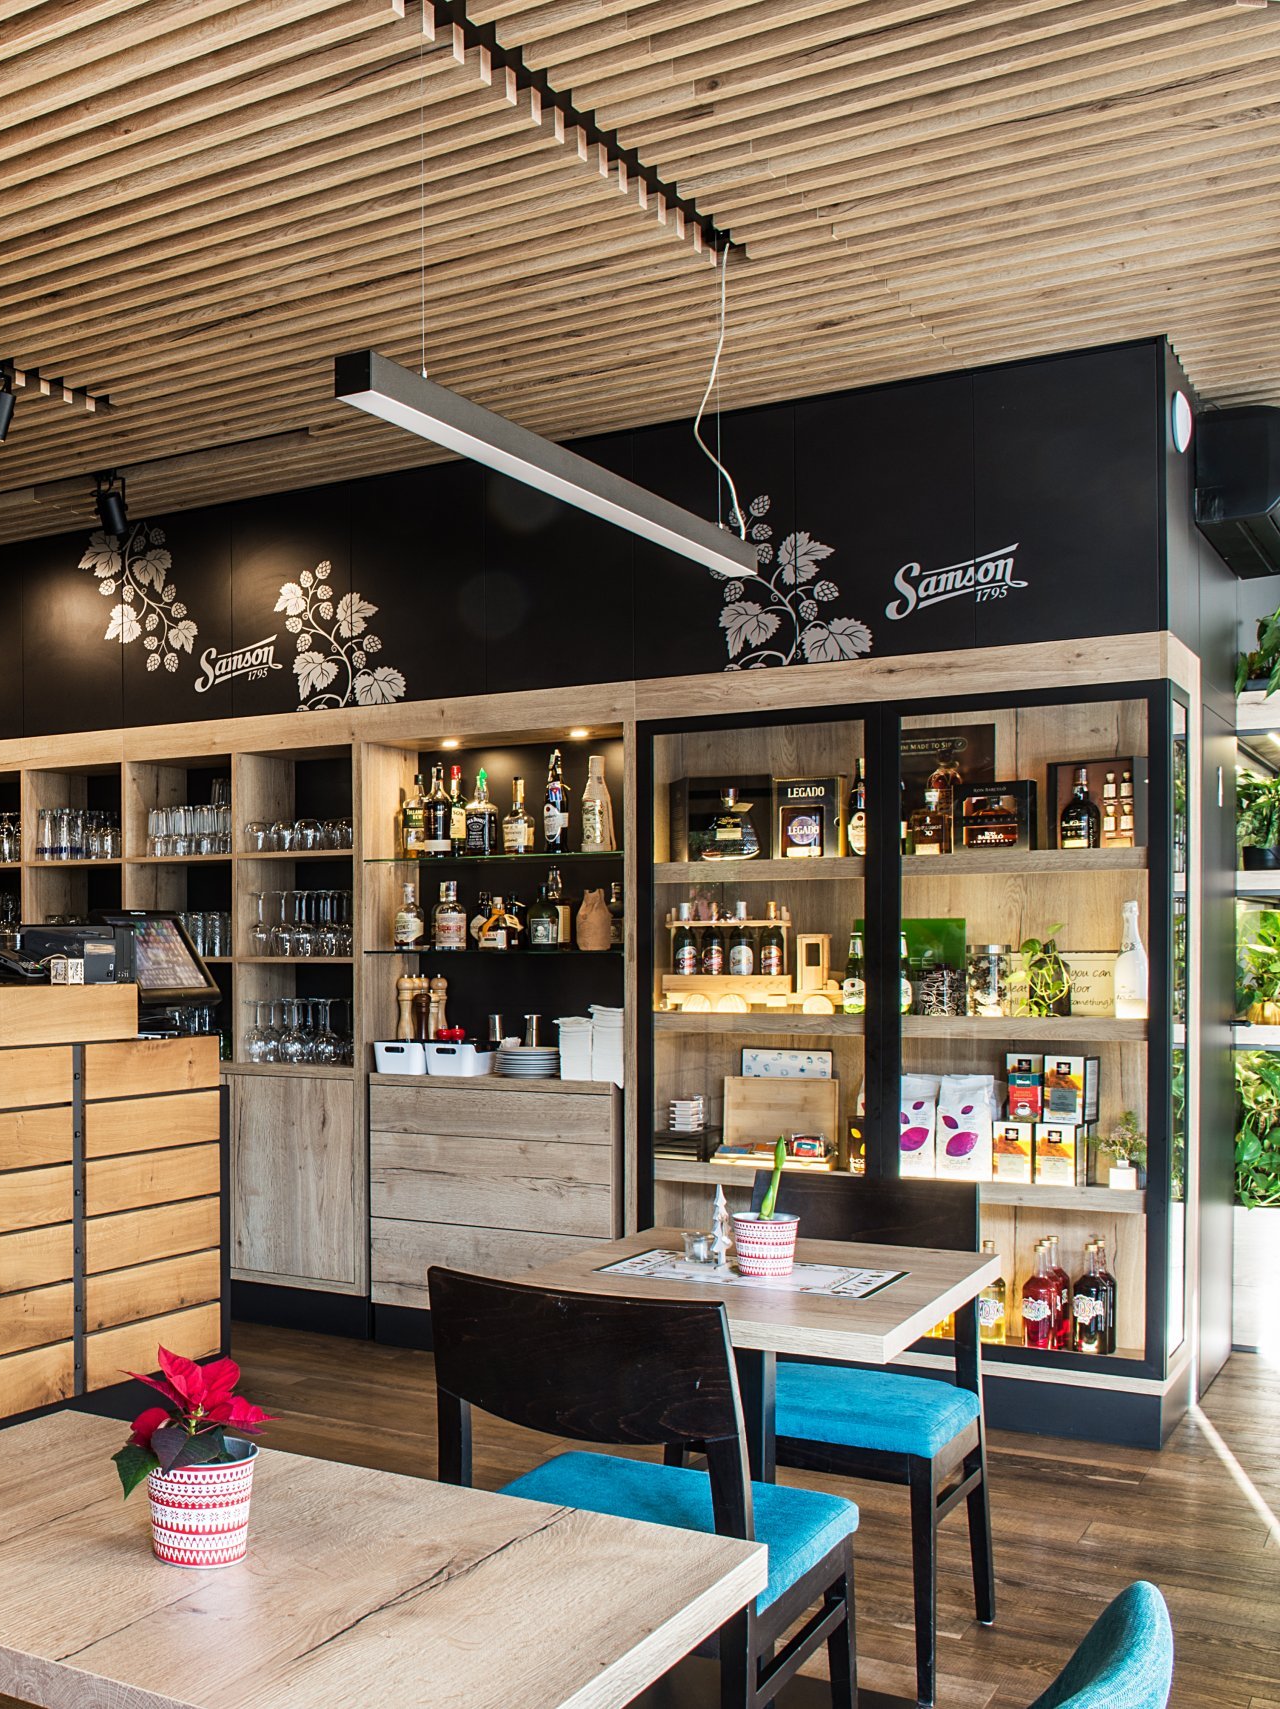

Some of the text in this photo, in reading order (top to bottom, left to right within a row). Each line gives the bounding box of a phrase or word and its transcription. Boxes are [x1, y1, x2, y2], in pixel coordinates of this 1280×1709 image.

[885, 543, 1029, 620] Samson
[975, 586, 1009, 602] 1795
[194, 634, 283, 693] Samson
[247, 668, 269, 681] 1795
[787, 786, 825, 798] LEGADO
[787, 825, 820, 836] LEGADO
[1092, 969, 1112, 978] can
